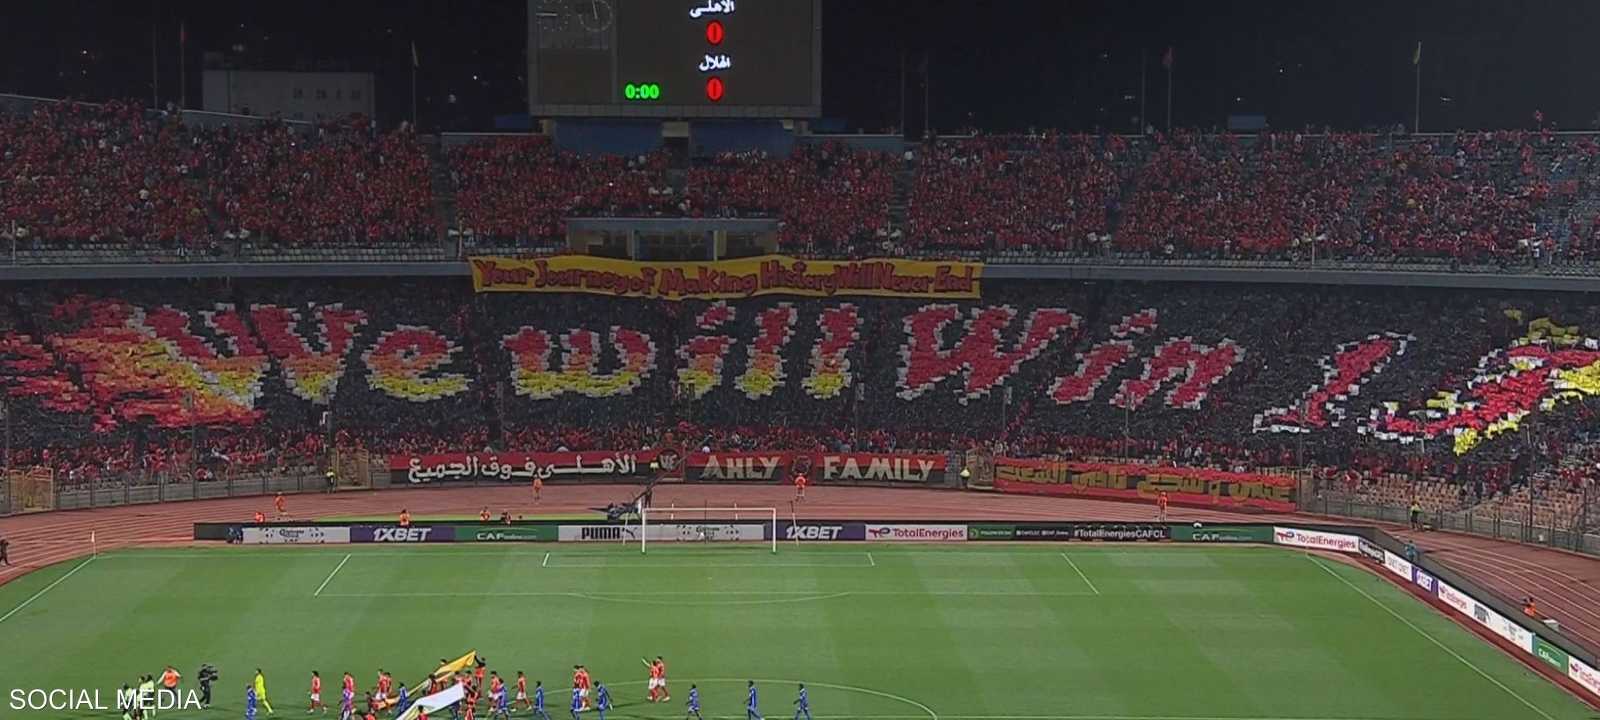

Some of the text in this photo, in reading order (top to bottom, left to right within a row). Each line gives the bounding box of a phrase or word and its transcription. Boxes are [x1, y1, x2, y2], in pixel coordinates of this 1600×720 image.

[707, 22, 723, 44] 0
[699, 54, 731, 71] الهلال
[625, 84, 660, 99] 0:00
[707, 78, 723, 100] 0
[475, 259, 534, 287] Your
[760, 260, 835, 296] History
[834, 263, 874, 289] Will
[874, 262, 933, 292] Never
[934, 265, 975, 292] End
[896, 303, 1247, 411] Win
[408, 455, 479, 483] الجميع
[701, 454, 936, 481] AHLY FAMILY
[373, 527, 432, 542] 1XBET
[581, 527, 621, 540] PUMA
[786, 526, 843, 540] 1XBET
[892, 527, 964, 541] TotalEnergies
[1073, 527, 1167, 540] #TotalEnergiesCAFCL
[1296, 533, 1356, 550] TotalEnergies
